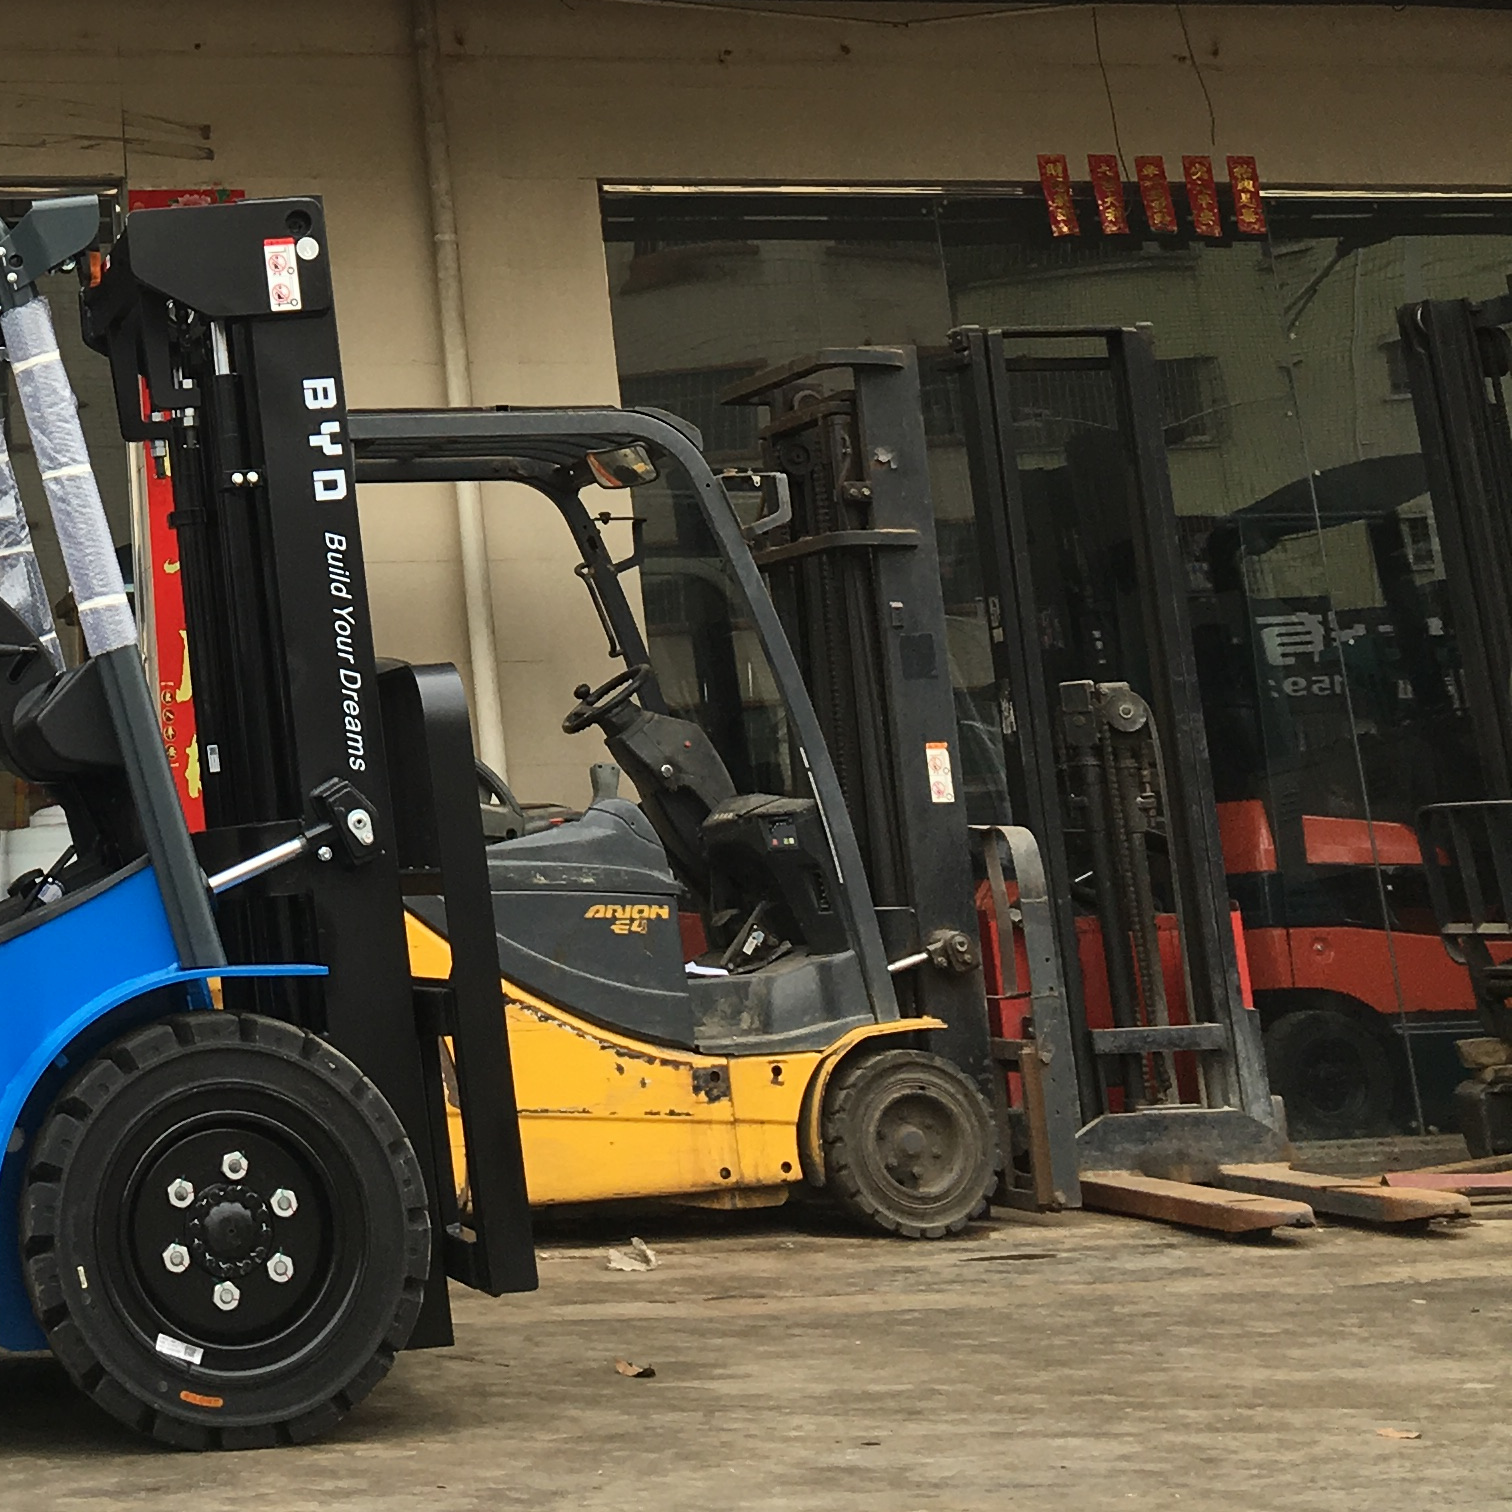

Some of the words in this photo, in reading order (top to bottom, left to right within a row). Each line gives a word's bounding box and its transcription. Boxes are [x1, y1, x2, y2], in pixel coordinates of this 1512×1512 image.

[303, 377, 347, 501] BYD
[325, 531, 353, 599] Build
[333, 606, 355, 664] Your
[340, 669, 366, 772] Dreams
